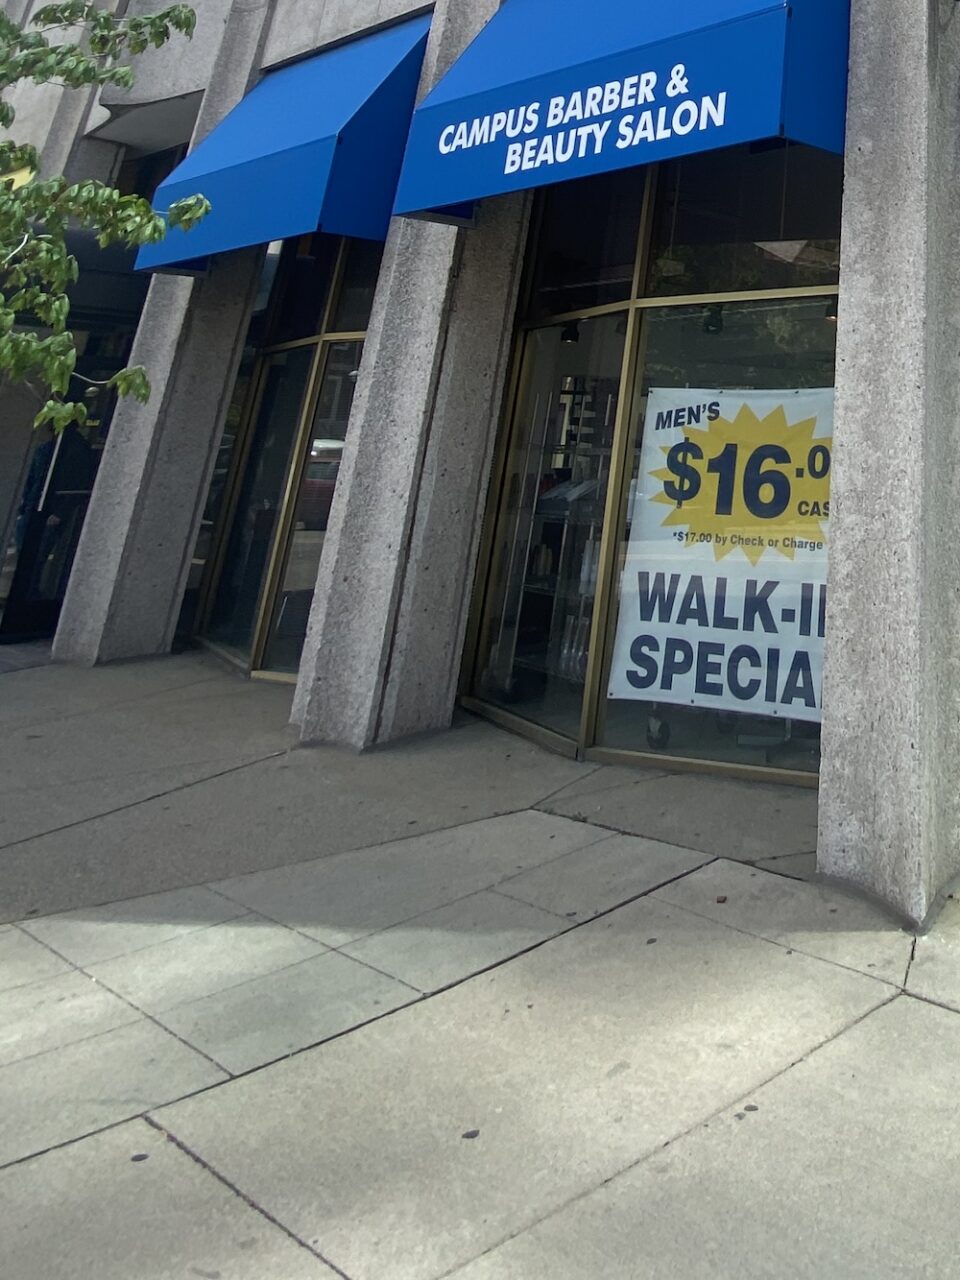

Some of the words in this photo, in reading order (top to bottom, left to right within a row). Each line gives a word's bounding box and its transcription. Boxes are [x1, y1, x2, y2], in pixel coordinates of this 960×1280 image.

[438, 102, 540, 155] CAMPUS
[546, 71, 657, 128] BARBER
[665, 63, 689, 97] &
[504, 121, 608, 175] BEAUTY
[616, 91, 727, 149] SALON
[655, 401, 720, 431] MEN'S
[663, 436, 831, 520] $16.0
[797, 500, 829, 518] CAS
[715, 533, 727, 546] by
[730, 534, 764, 547] Check
[767, 538, 779, 548] or
[782, 537, 824, 551] Charge
[626, 634, 822, 710] SPECIA
